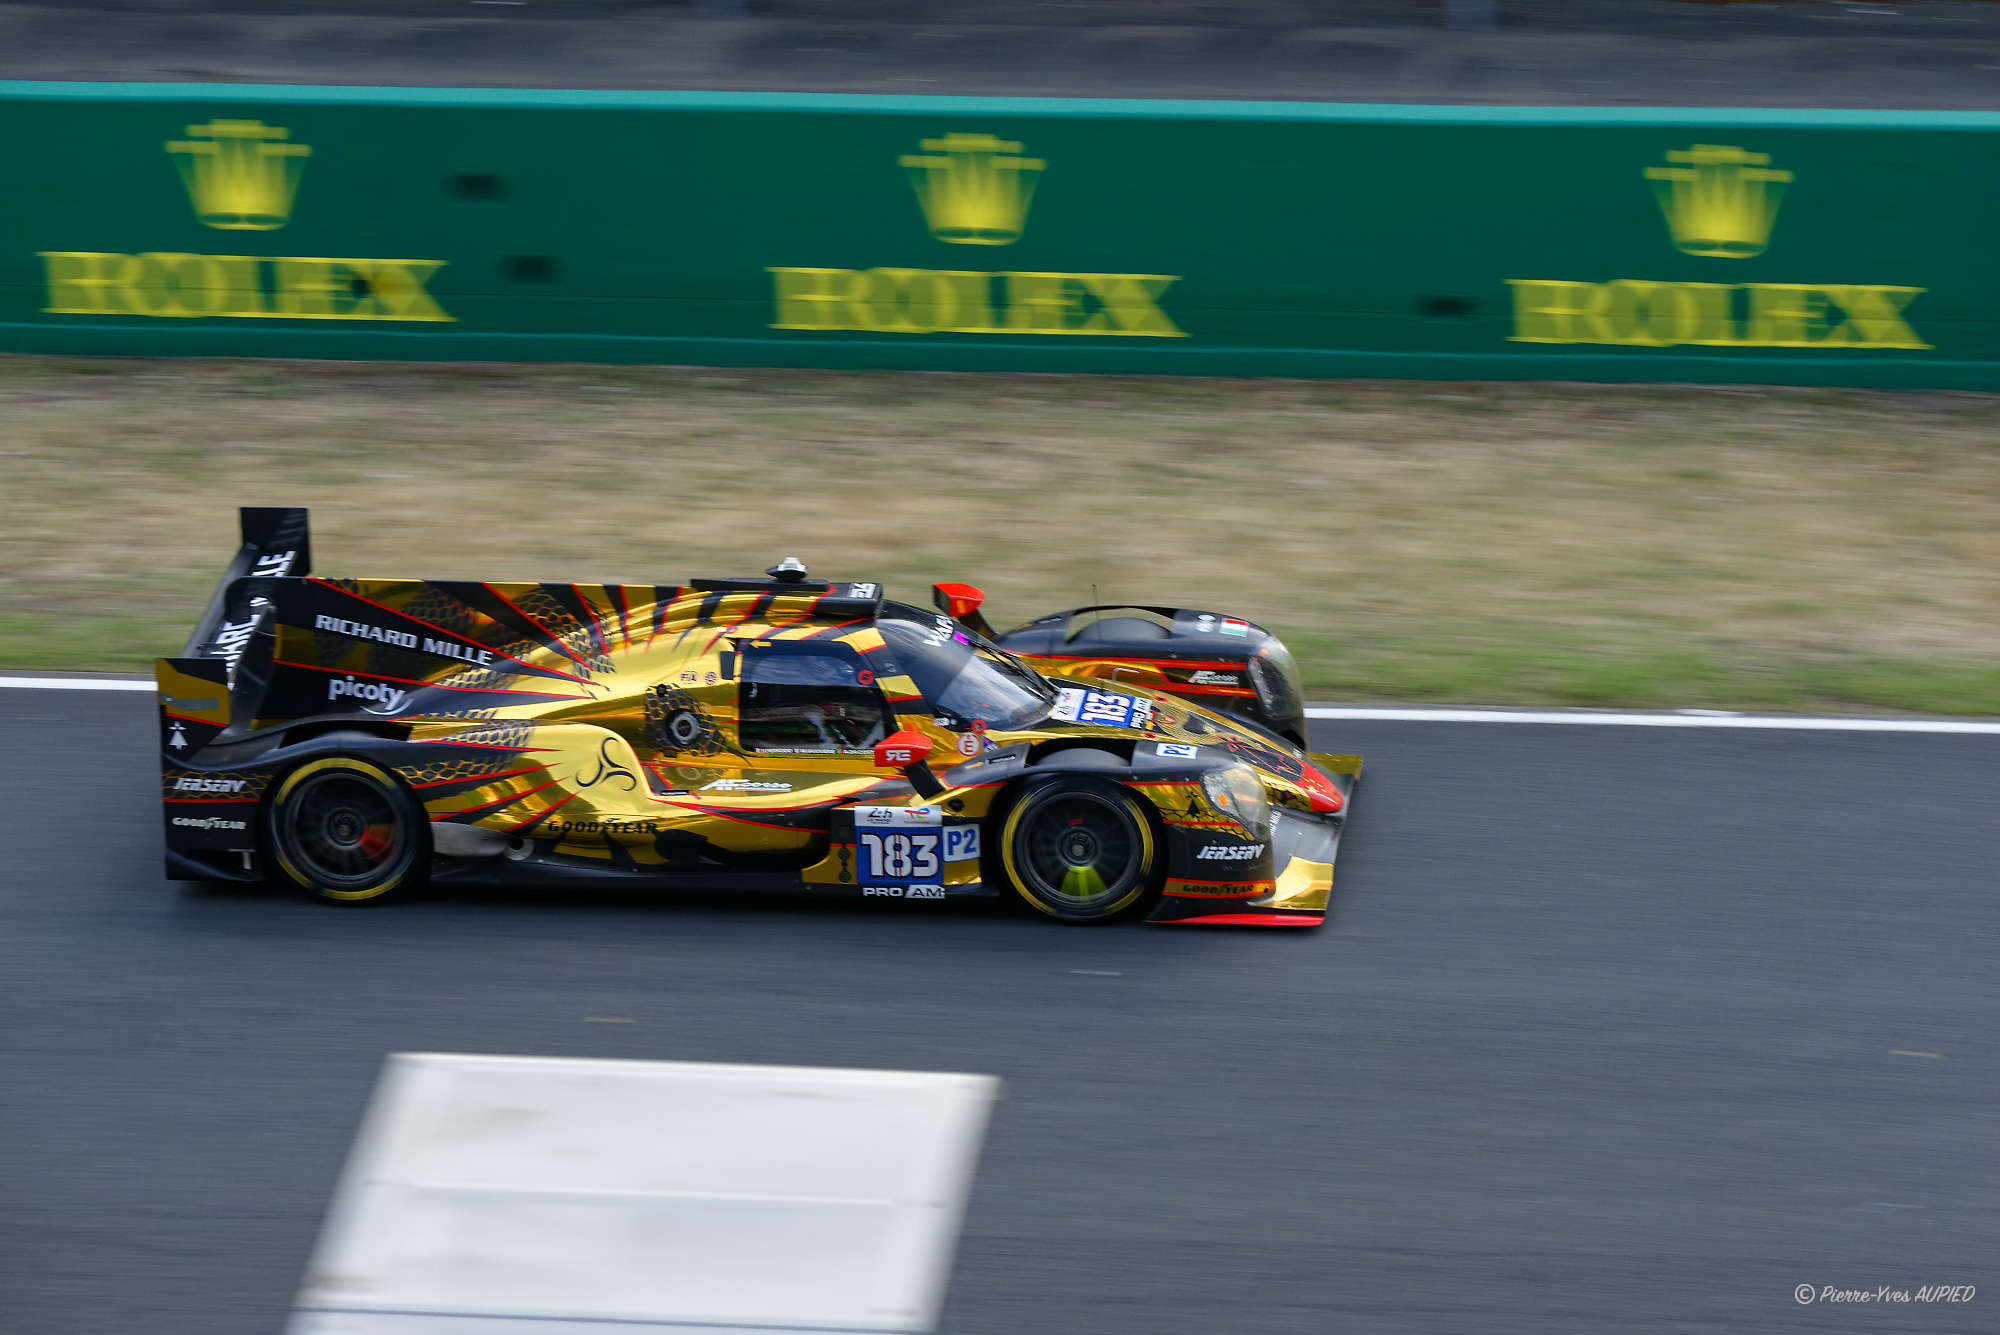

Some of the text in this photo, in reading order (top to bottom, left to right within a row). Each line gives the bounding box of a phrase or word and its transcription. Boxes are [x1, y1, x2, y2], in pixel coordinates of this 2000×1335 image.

[36, 251, 458, 322] ROLEX
[764, 267, 1192, 338] ROLEX
[1504, 279, 1937, 350] ROLEX
[315, 614, 494, 666] RICHARD MILLE
[328, 675, 406, 711] picoty
[1080, 692, 1132, 723] 183
[1163, 744, 1191, 757] P2
[547, 816, 658, 835] GOODYEAR
[947, 828, 978, 857] P2
[860, 833, 939, 877] 183
[862, 886, 944, 897] PRO AM
